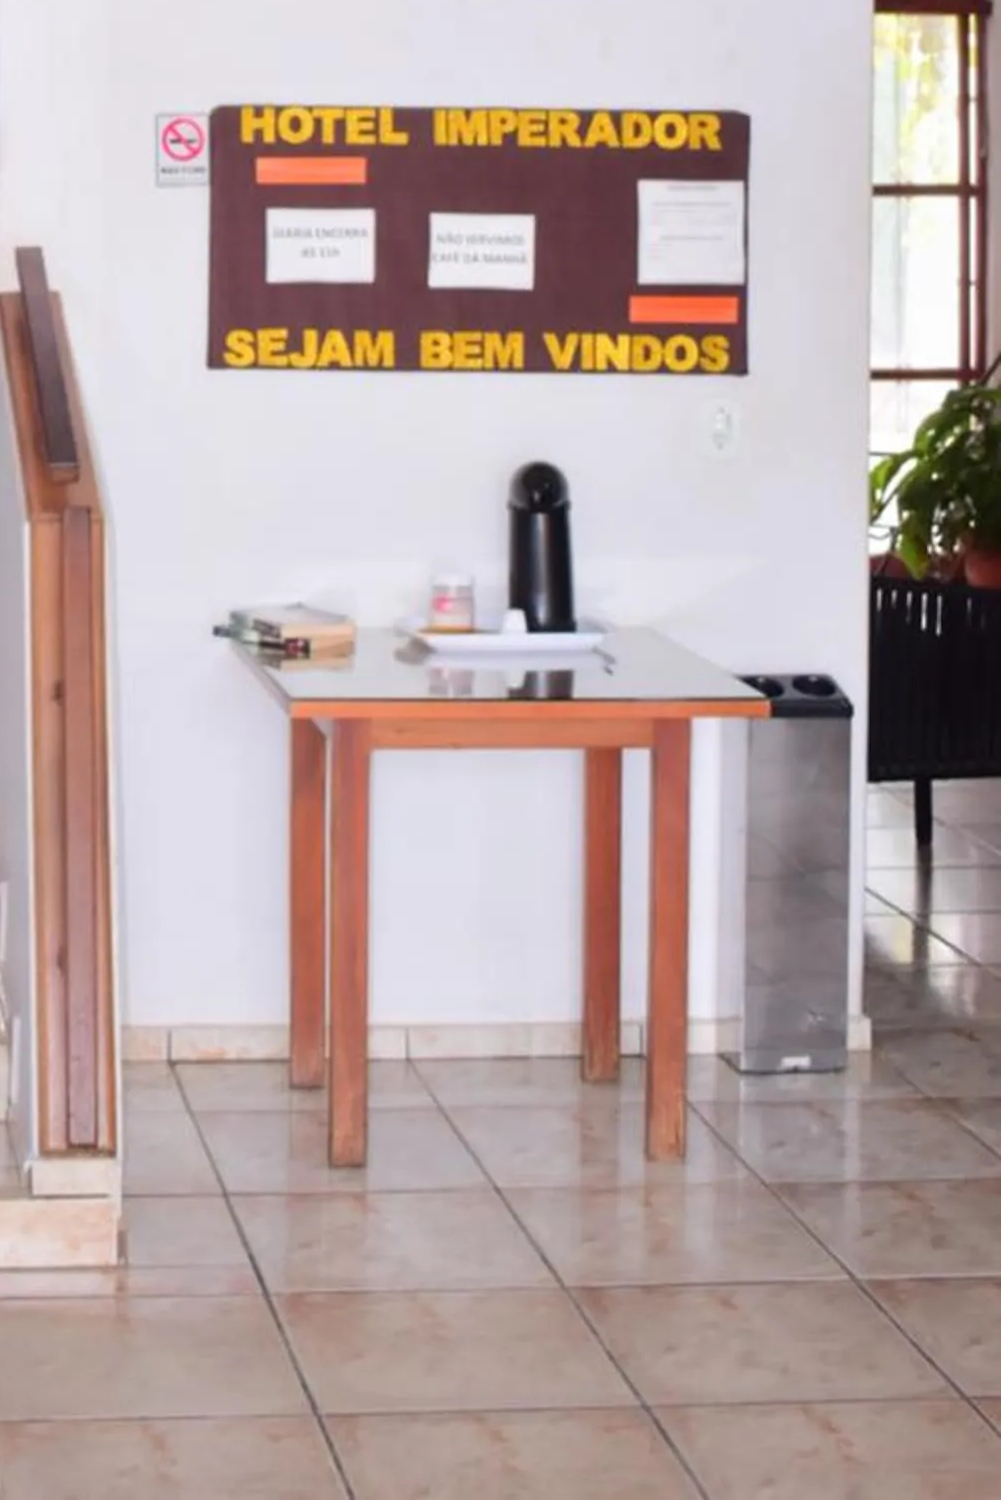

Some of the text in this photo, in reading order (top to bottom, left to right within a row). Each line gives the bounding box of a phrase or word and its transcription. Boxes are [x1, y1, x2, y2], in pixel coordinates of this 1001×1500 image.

[240, 105, 722, 150] HOTEL IMPERADOR
[223, 327, 730, 373] SEJAM BEM VINDOS
